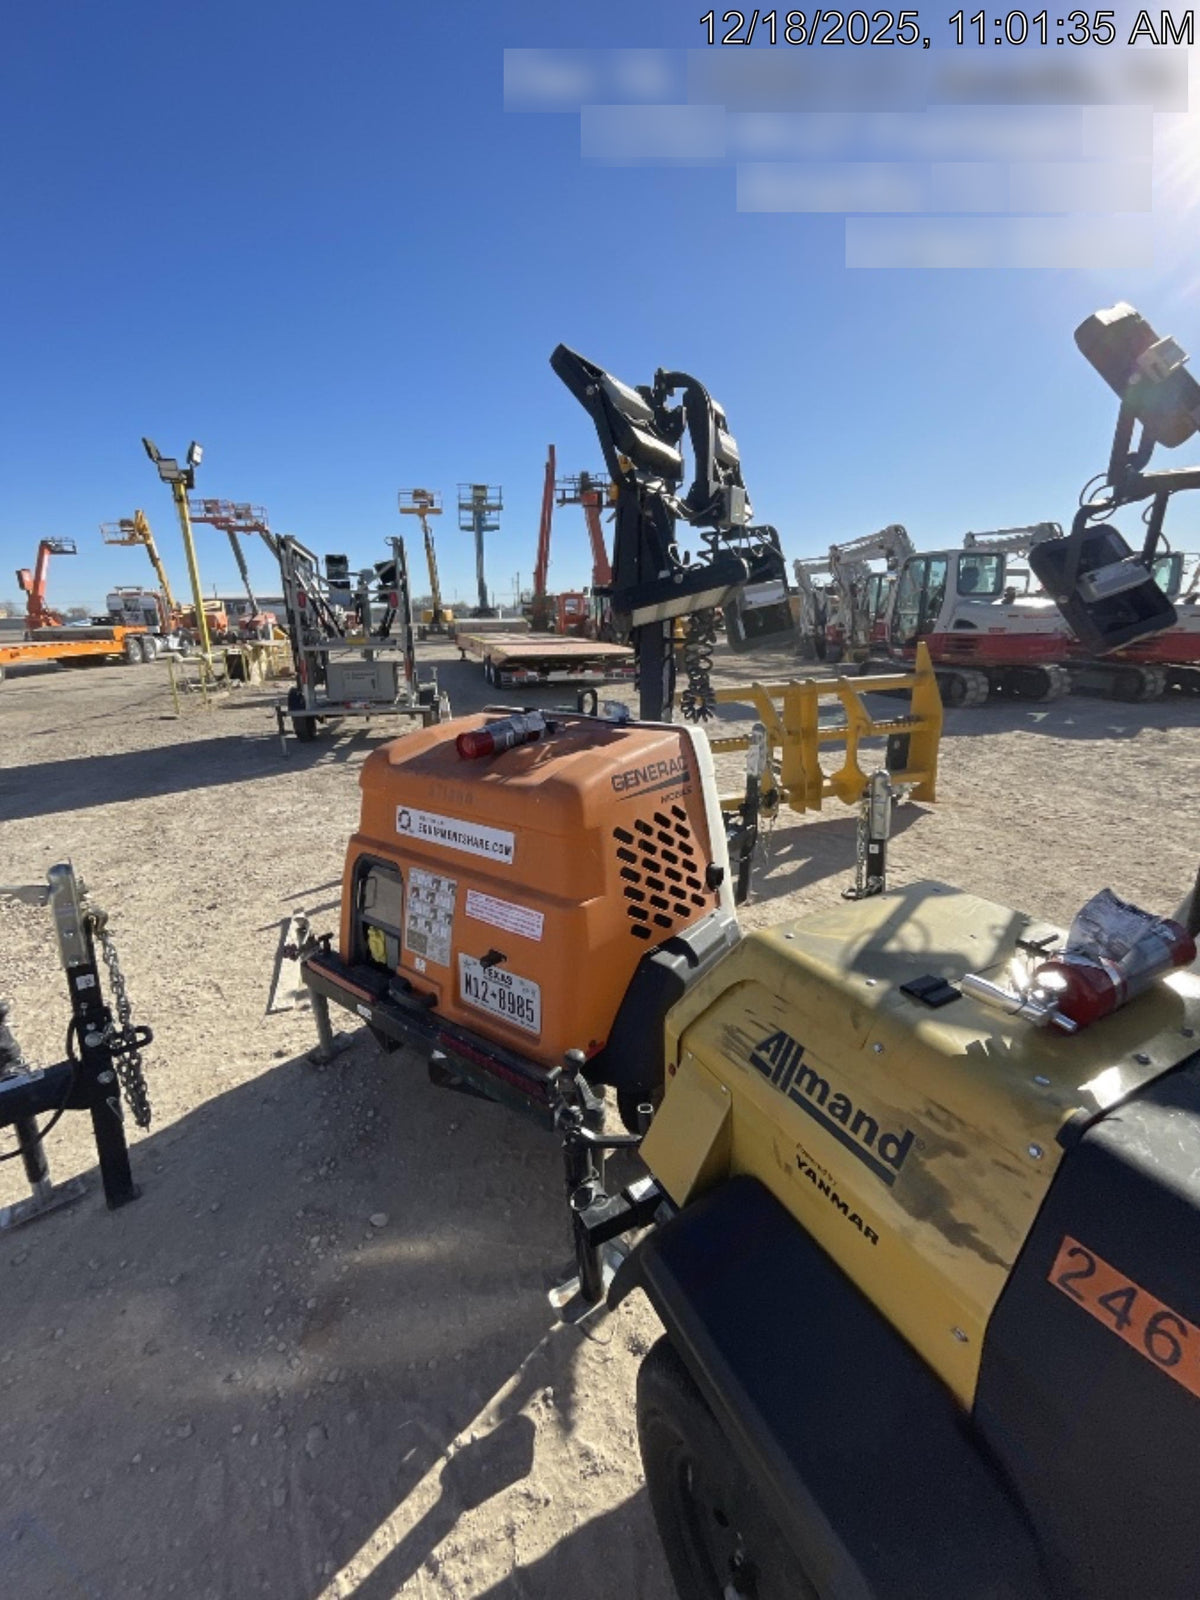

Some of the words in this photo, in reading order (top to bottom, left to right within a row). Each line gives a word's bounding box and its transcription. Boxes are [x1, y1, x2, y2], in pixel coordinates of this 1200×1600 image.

[611, 755, 689, 793] GENERAC
[751, 1031, 915, 1172] Allmand
[796, 1153, 879, 1246] YANMAR
